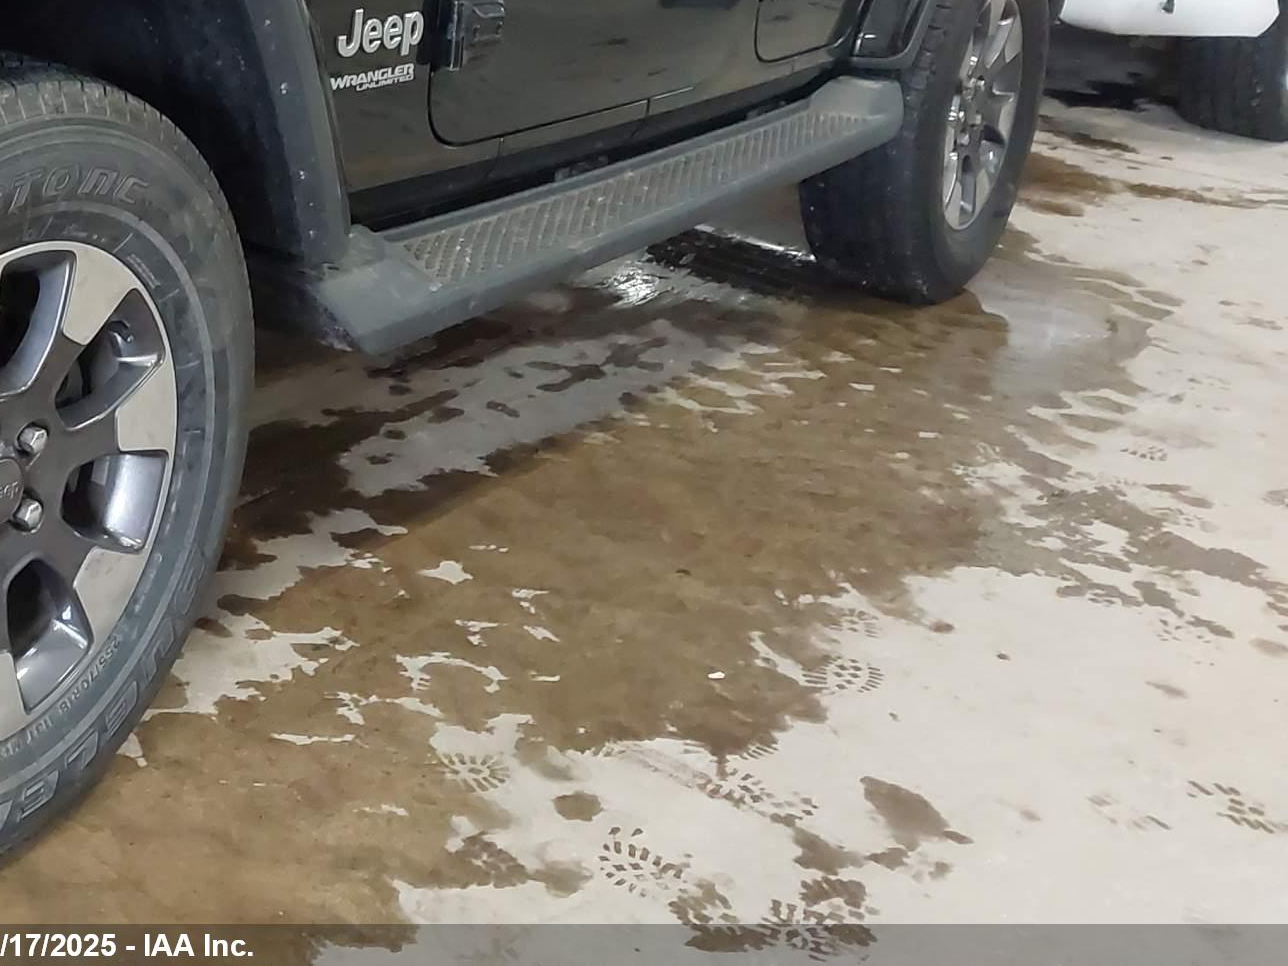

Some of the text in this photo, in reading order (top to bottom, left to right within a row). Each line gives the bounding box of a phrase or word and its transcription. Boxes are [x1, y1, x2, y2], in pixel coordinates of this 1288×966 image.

[336, 8, 424, 58] Jeep
[330, 62, 415, 91] WRANGLER
[356, 73, 415, 92] UNLIMITED
